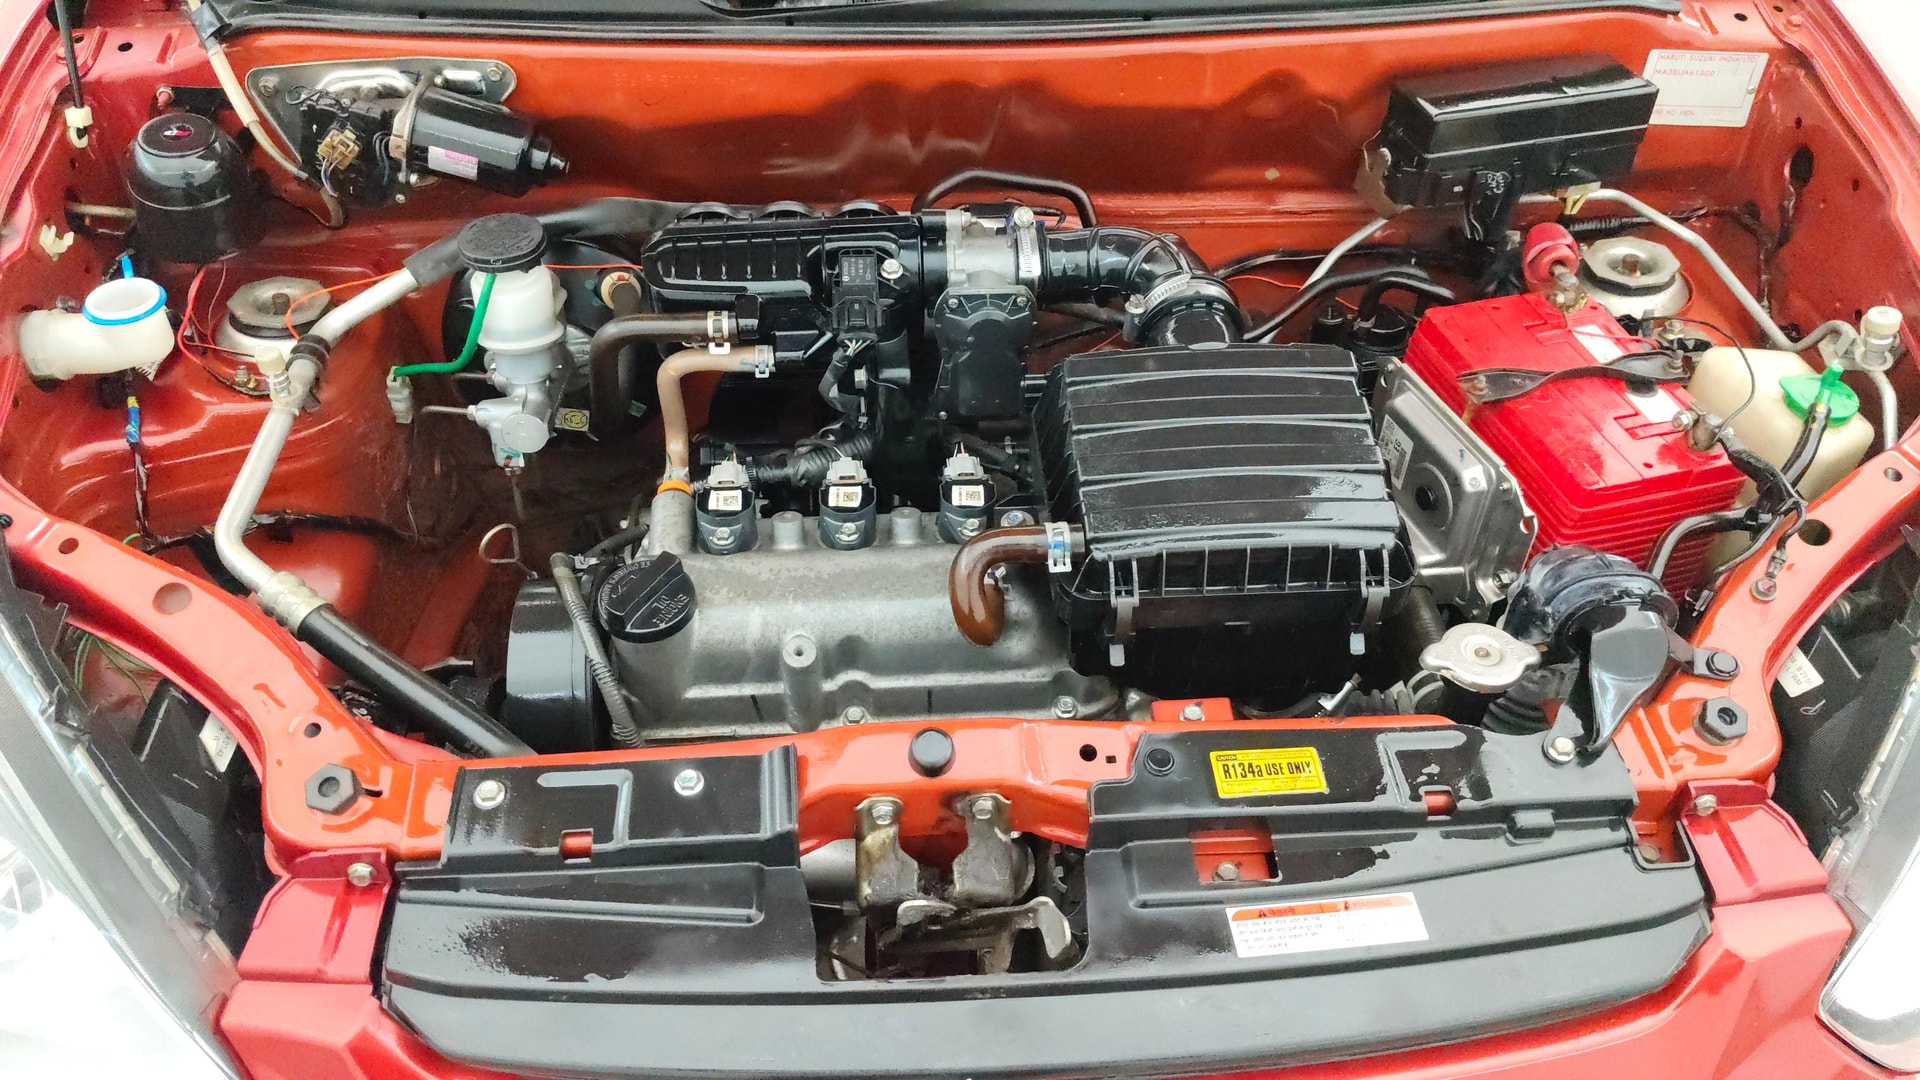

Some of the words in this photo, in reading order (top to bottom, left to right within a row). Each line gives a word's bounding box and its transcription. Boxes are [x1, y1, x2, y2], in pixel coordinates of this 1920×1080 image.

[1660, 54, 1686, 62] MARUTI
[1222, 761, 1264, 779] R134a
[1264, 761, 1285, 775] USE
[1287, 760, 1312, 774] ONLY
